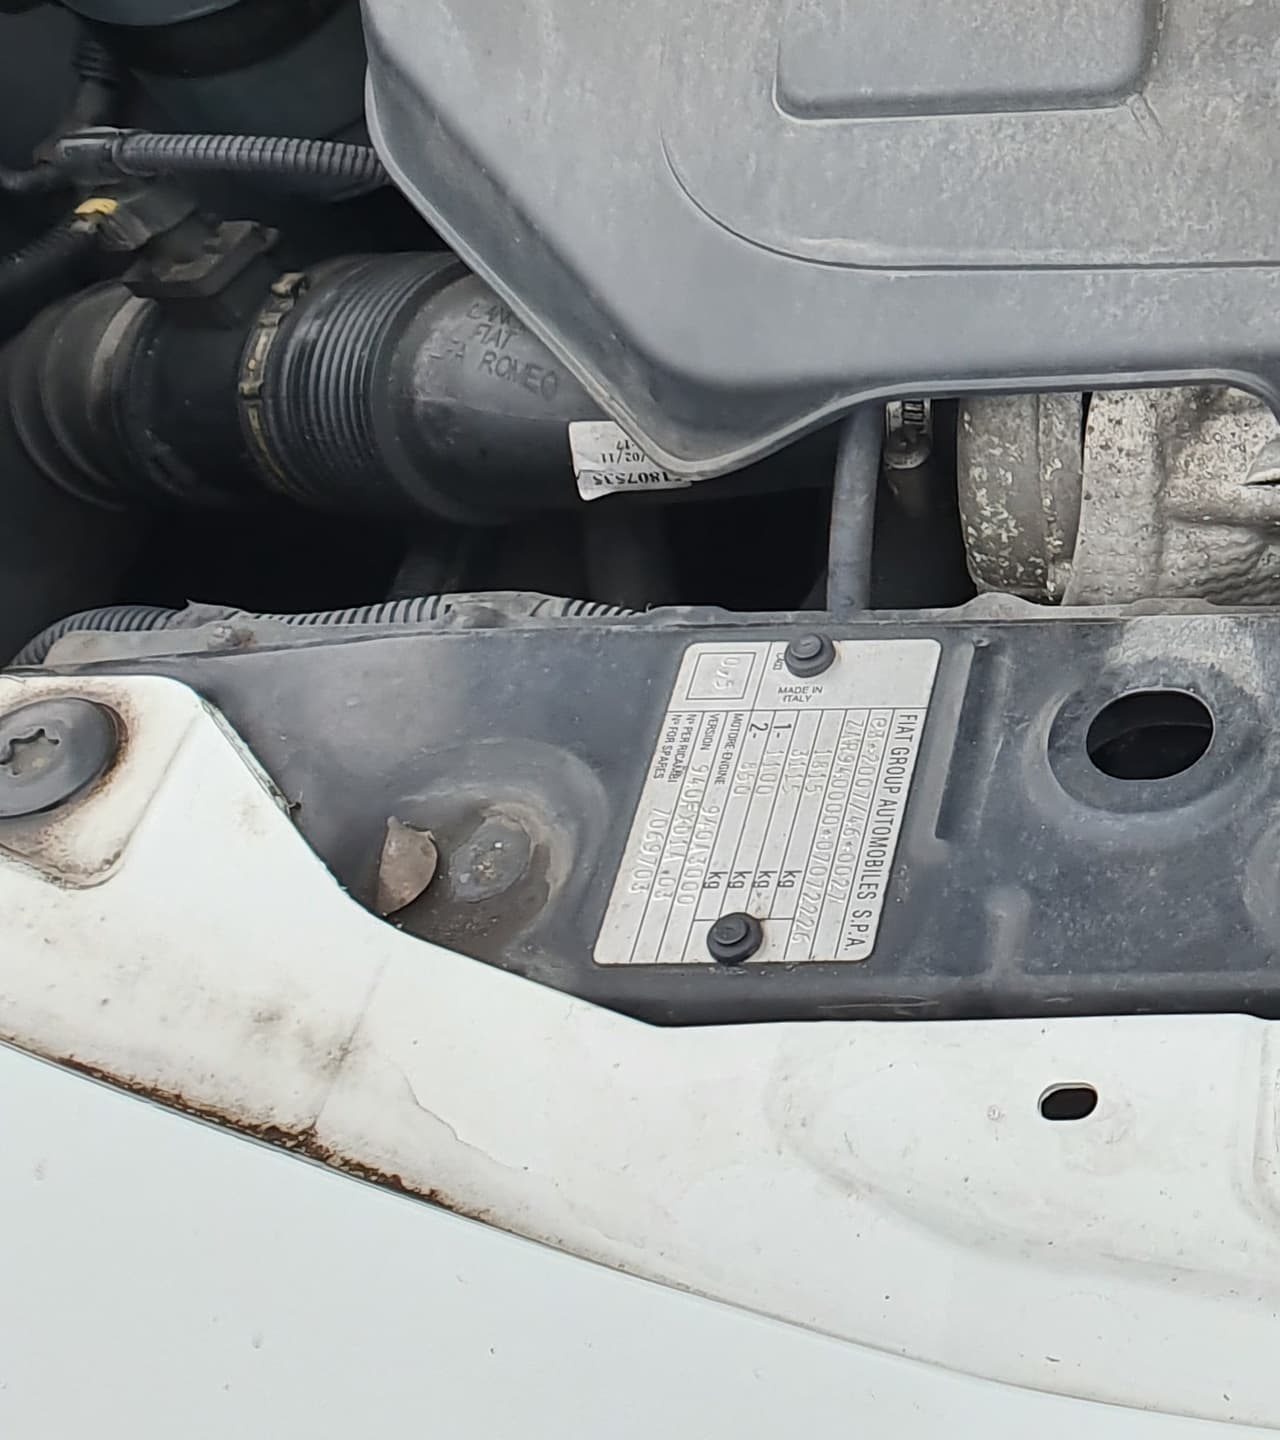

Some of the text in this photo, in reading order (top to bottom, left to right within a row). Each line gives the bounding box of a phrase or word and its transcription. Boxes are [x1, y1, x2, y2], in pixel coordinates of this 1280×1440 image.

[778, 686, 823, 695] MADE IN
[782, 695, 813, 703] ITALY
[663, 726, 679, 744] FOR
[679, 726, 694, 743] PER
[700, 714, 720, 751] VERSION
[893, 714, 917, 742] FIAT
[653, 746, 674, 779] SPARES
[667, 745, 688, 783] RICAMBI
[879, 747, 911, 794] GROUP
[856, 799, 897, 900] AUTOMOBILES
[704, 871, 729, 889] kg
[729, 870, 753, 889] kg
[754, 869, 777, 888] kg
[778, 869, 801, 888] kg
